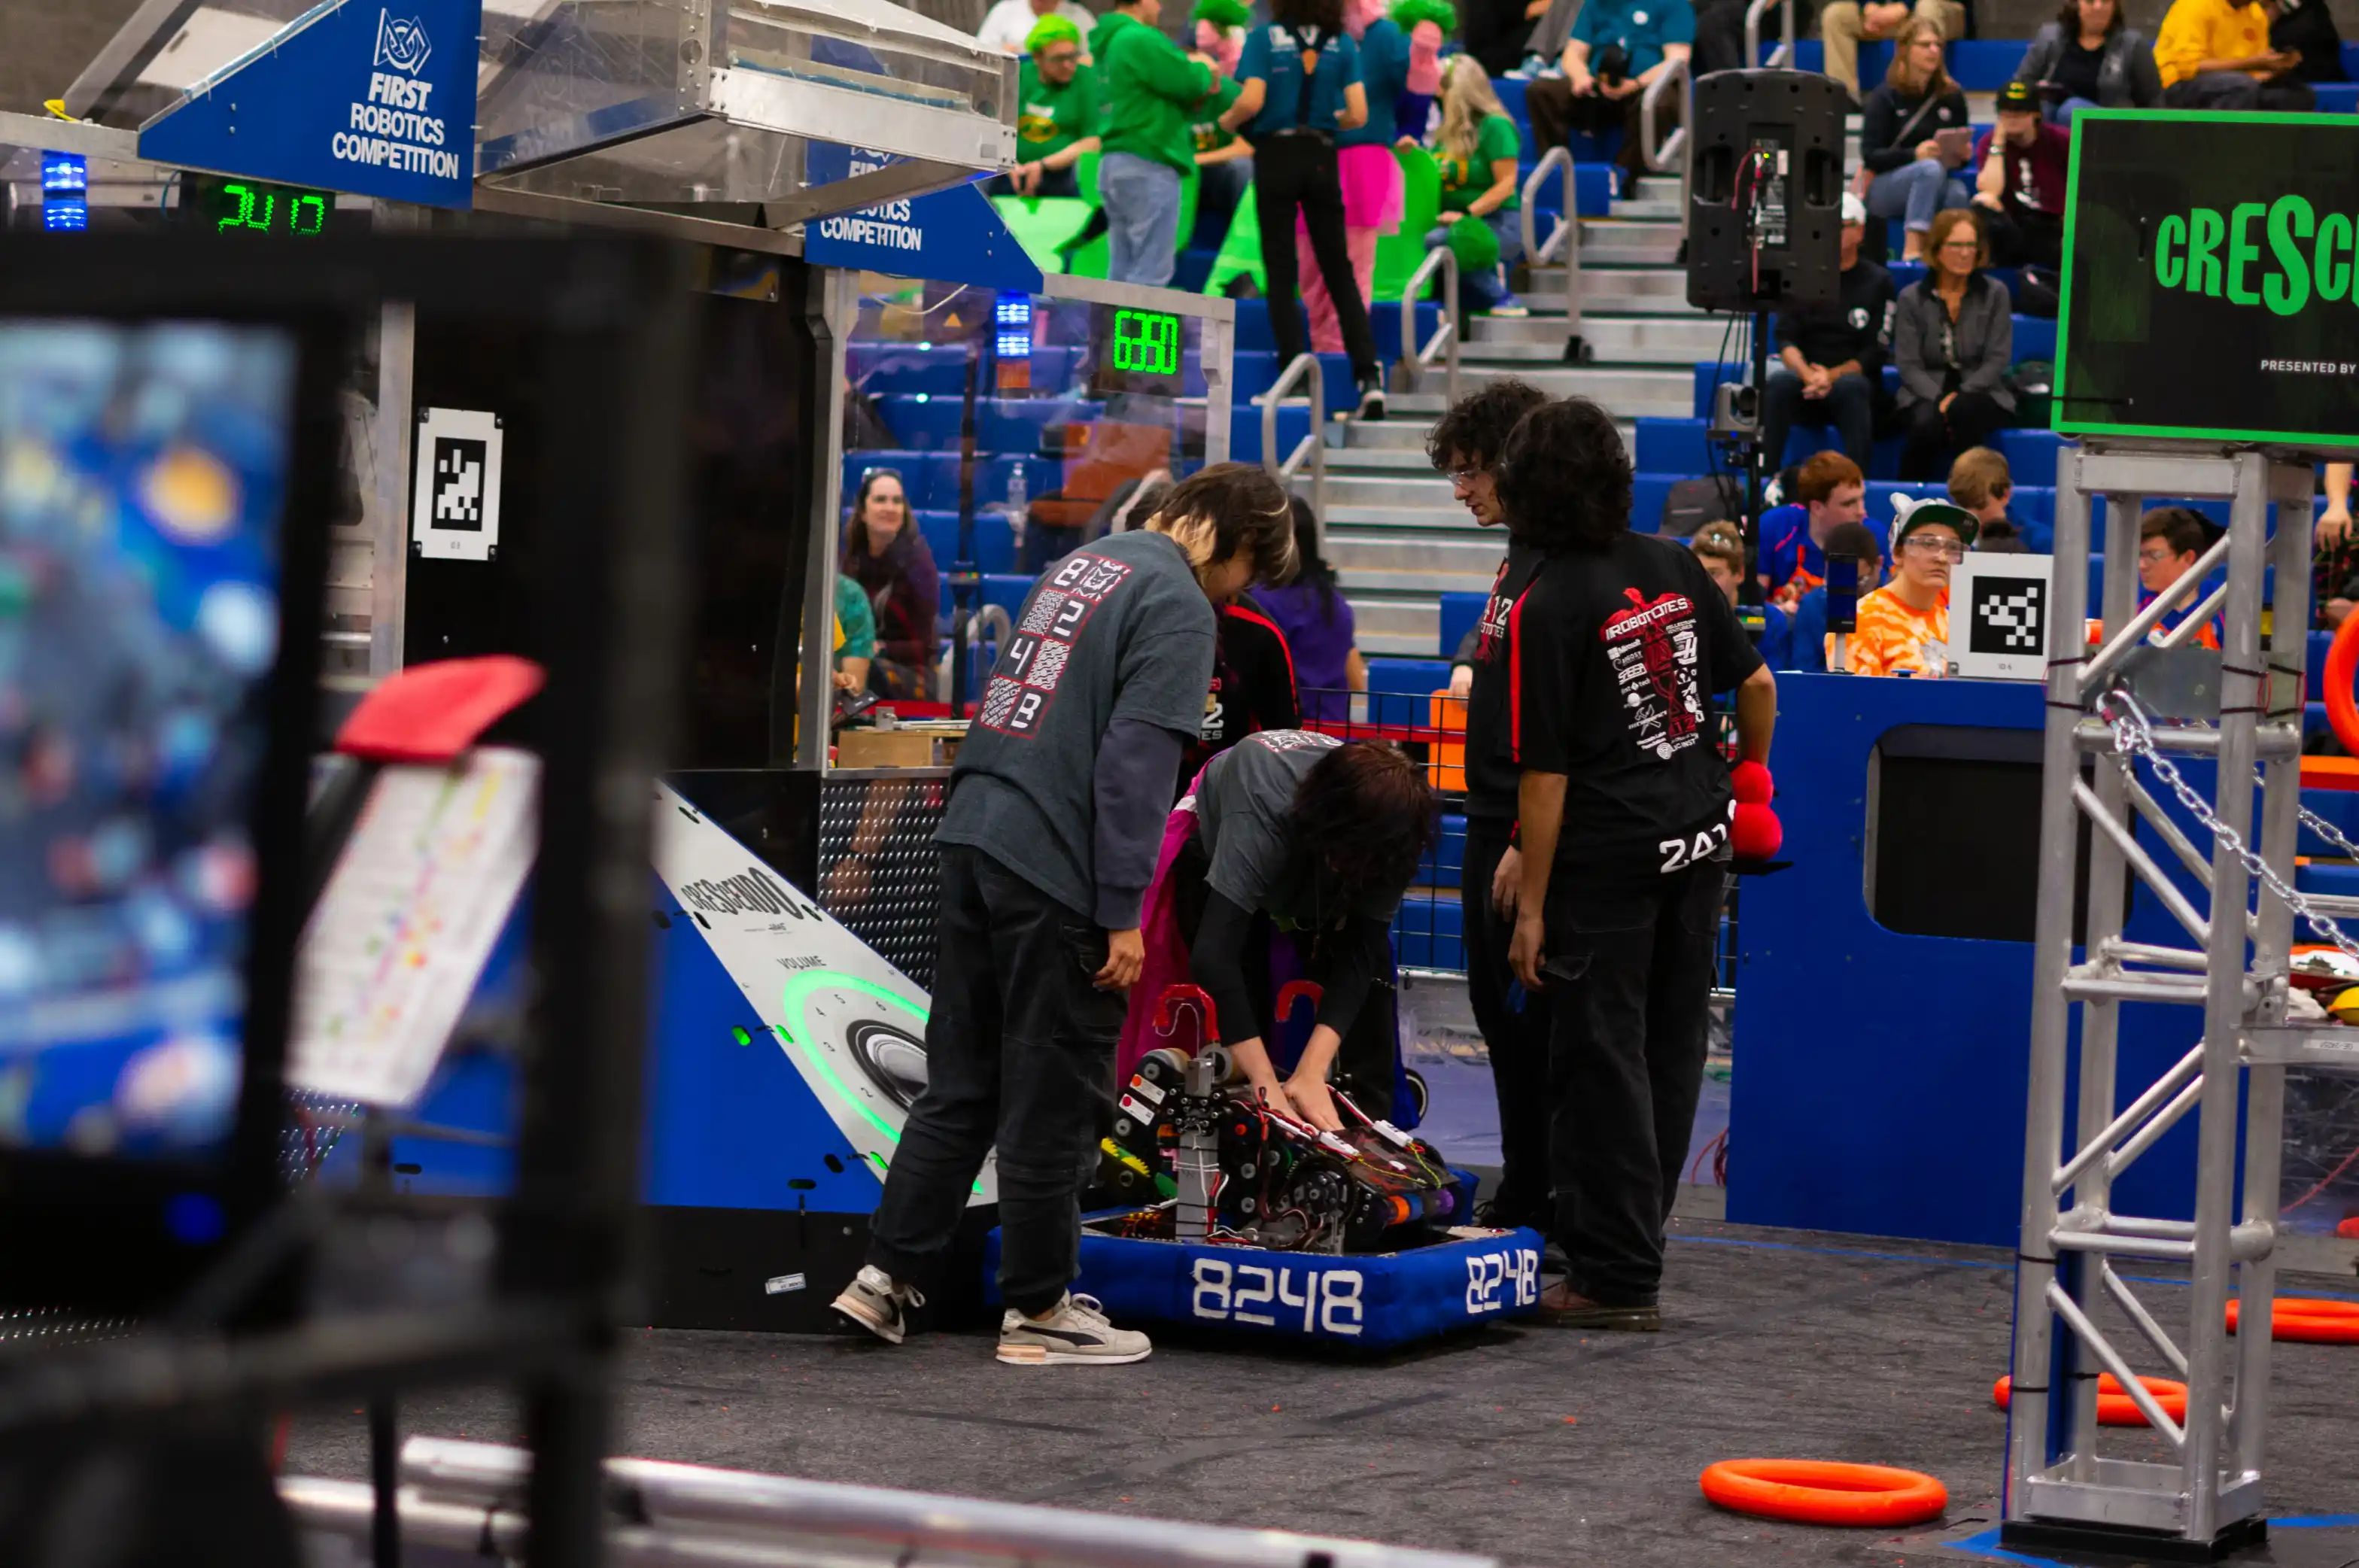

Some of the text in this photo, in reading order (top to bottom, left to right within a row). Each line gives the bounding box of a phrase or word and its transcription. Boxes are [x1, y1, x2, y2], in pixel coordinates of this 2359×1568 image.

[368, 71, 432, 111] FIRST
[351, 102, 445, 145] ROBOTICS
[332, 132, 459, 180] COMPETITION
[820, 216, 922, 251] COMPETITION
[2155, 194, 2359, 316] CRESC
[1114, 310, 1178, 375] 6350
[2260, 359, 2357, 374] PRESENTED BY
[1053, 558, 1090, 587] 8
[1053, 600, 1084, 637] 2
[1010, 637, 1034, 674] 4
[680, 867, 804, 920] CRESCENDO
[776, 955, 827, 970] VOLUME
[1191, 1249, 1538, 1337] 8248 8248
